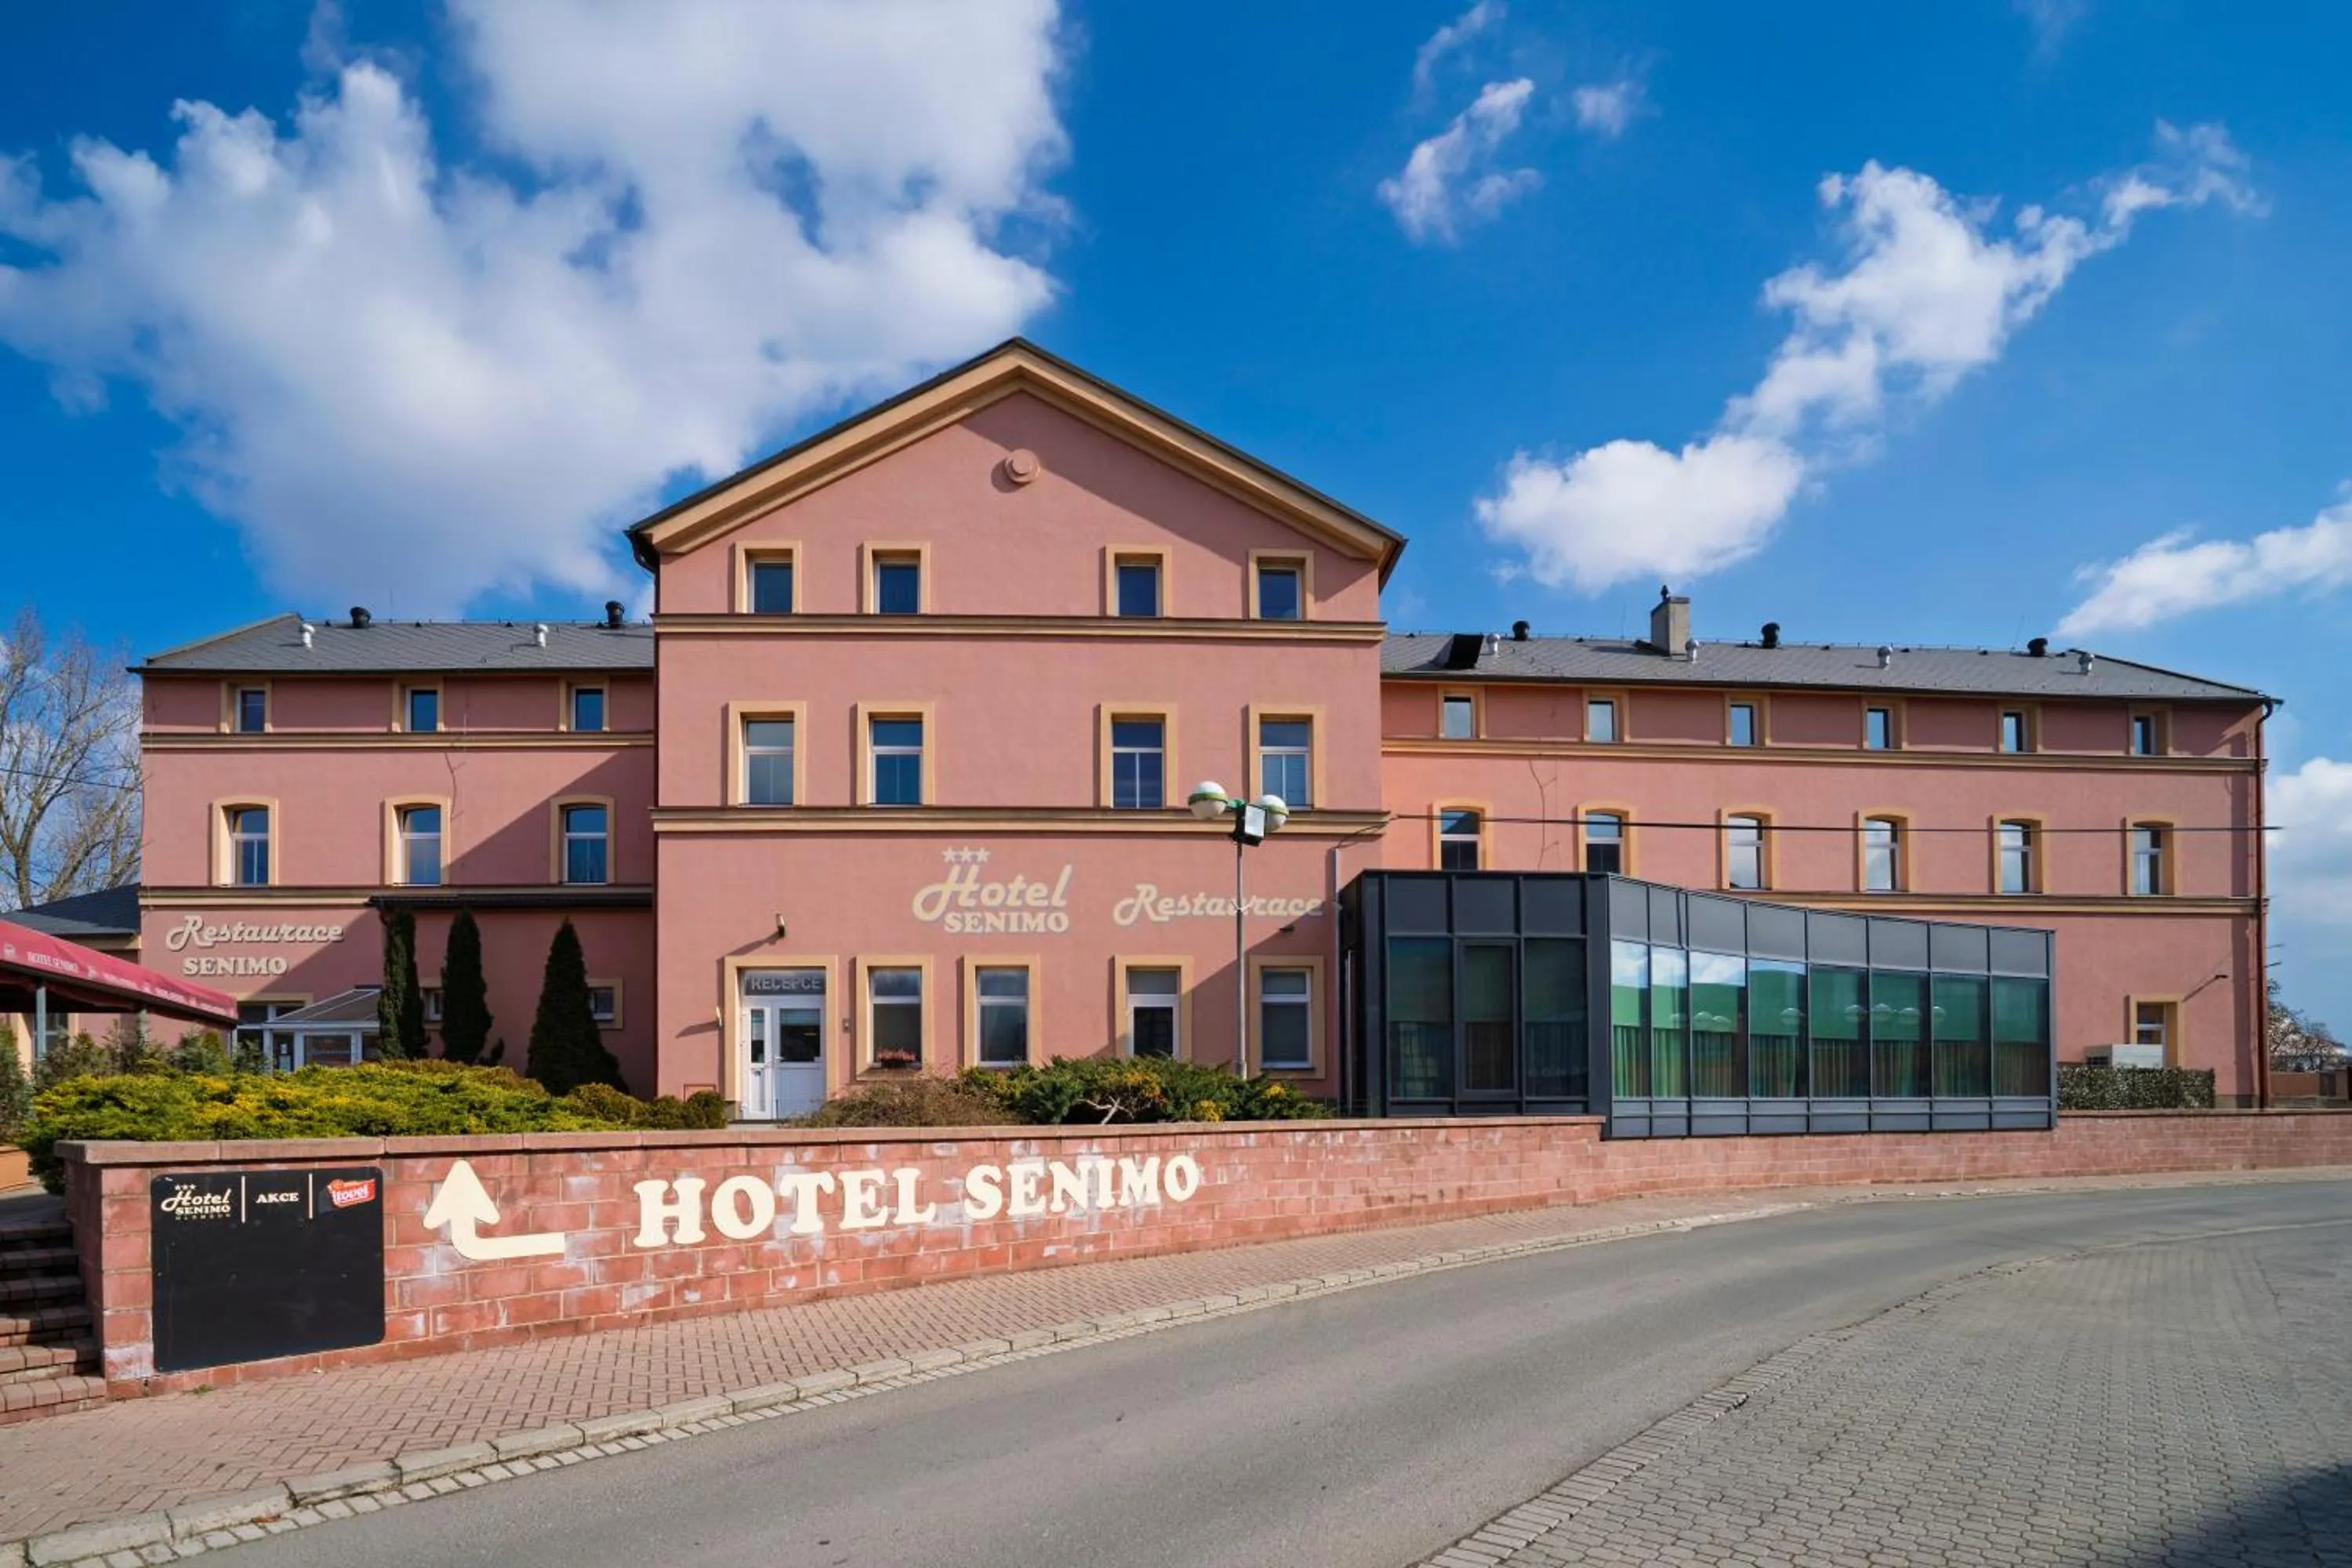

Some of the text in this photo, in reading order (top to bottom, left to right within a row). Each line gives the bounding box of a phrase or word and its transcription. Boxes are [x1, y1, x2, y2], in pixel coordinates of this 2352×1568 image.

[913, 863, 1073, 922] Hotel
[1112, 883, 1323, 926] Restaurace
[165, 915, 344, 952] Restaurace
[944, 910, 1069, 934] SENIMO
[182, 956, 289, 976] SENIMO
[751, 977, 821, 990] RECEPCE
[161, 1188, 232, 1212] Hotel
[255, 1192, 299, 1203] AKCE
[632, 1155, 1200, 1248] HOTEL SENIMO
[175, 1204, 231, 1216] SENIMO
